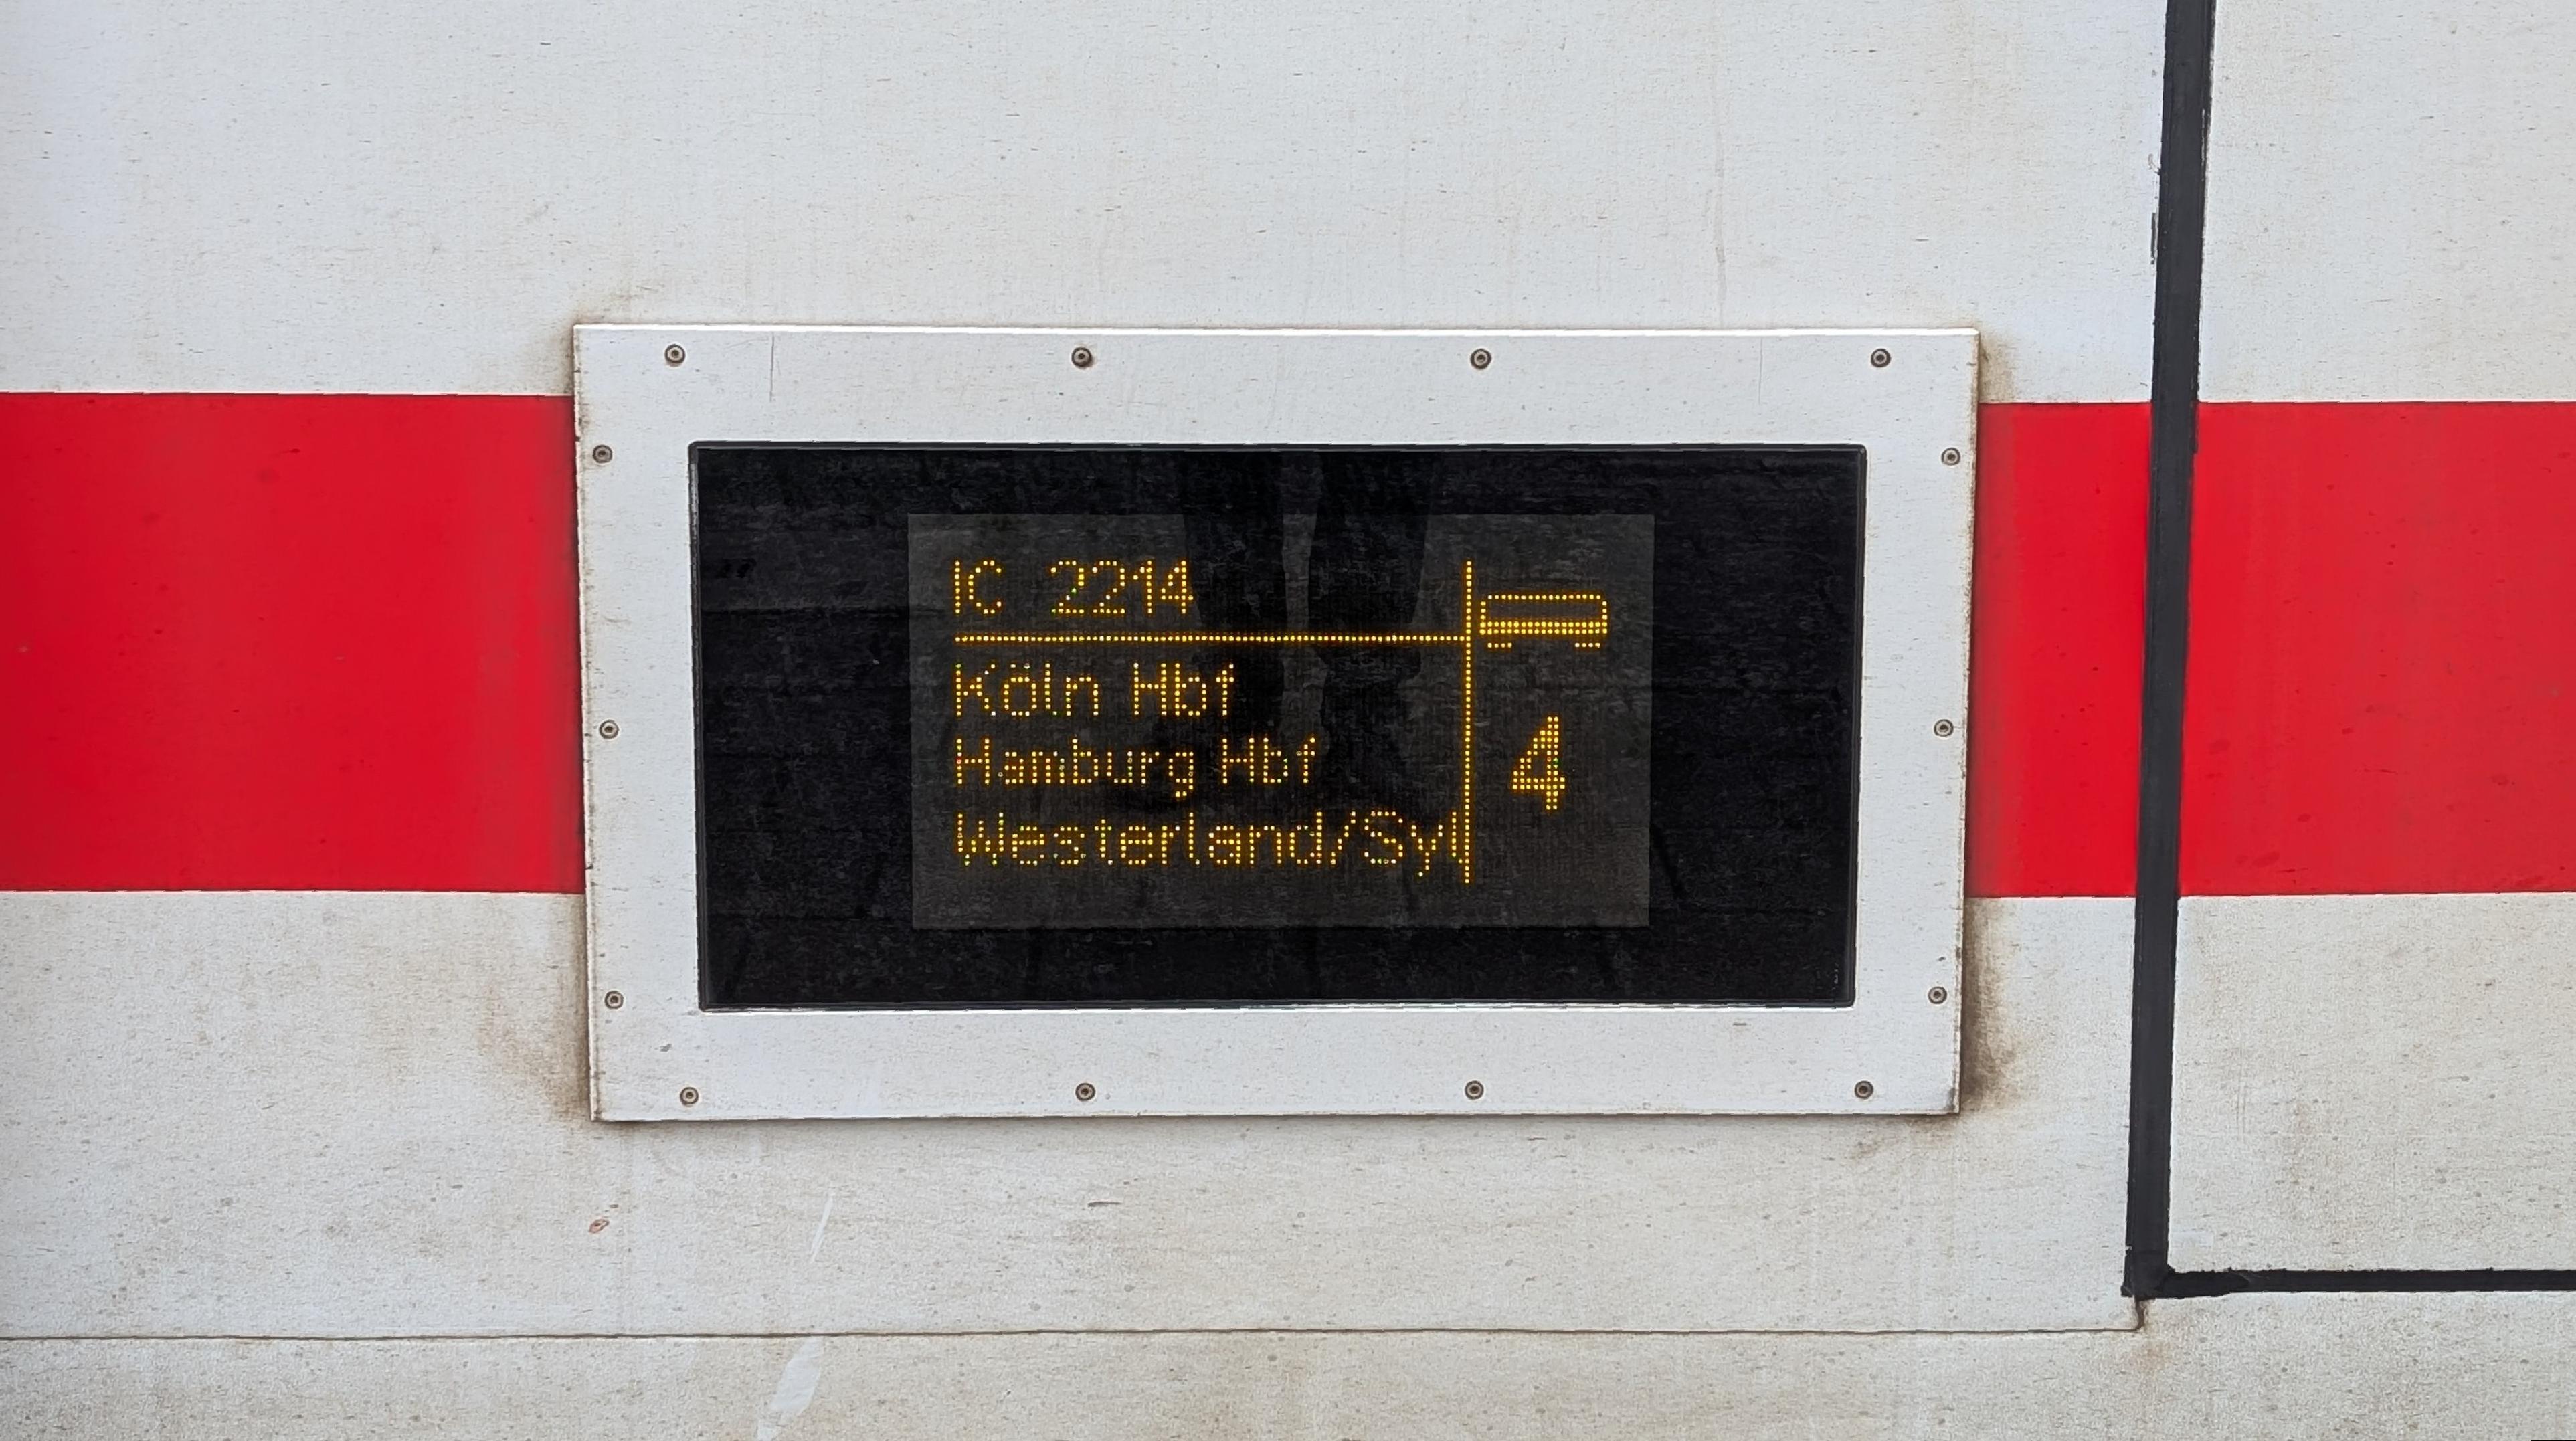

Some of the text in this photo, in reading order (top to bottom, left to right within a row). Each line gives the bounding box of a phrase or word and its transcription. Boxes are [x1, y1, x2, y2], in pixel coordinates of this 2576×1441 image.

[954, 558, 1195, 615] IC 2214
[955, 661, 1235, 718] Köln Hbf
[955, 736, 1316, 799] Hamburg Hbf
[1510, 714, 1566, 812] 4
